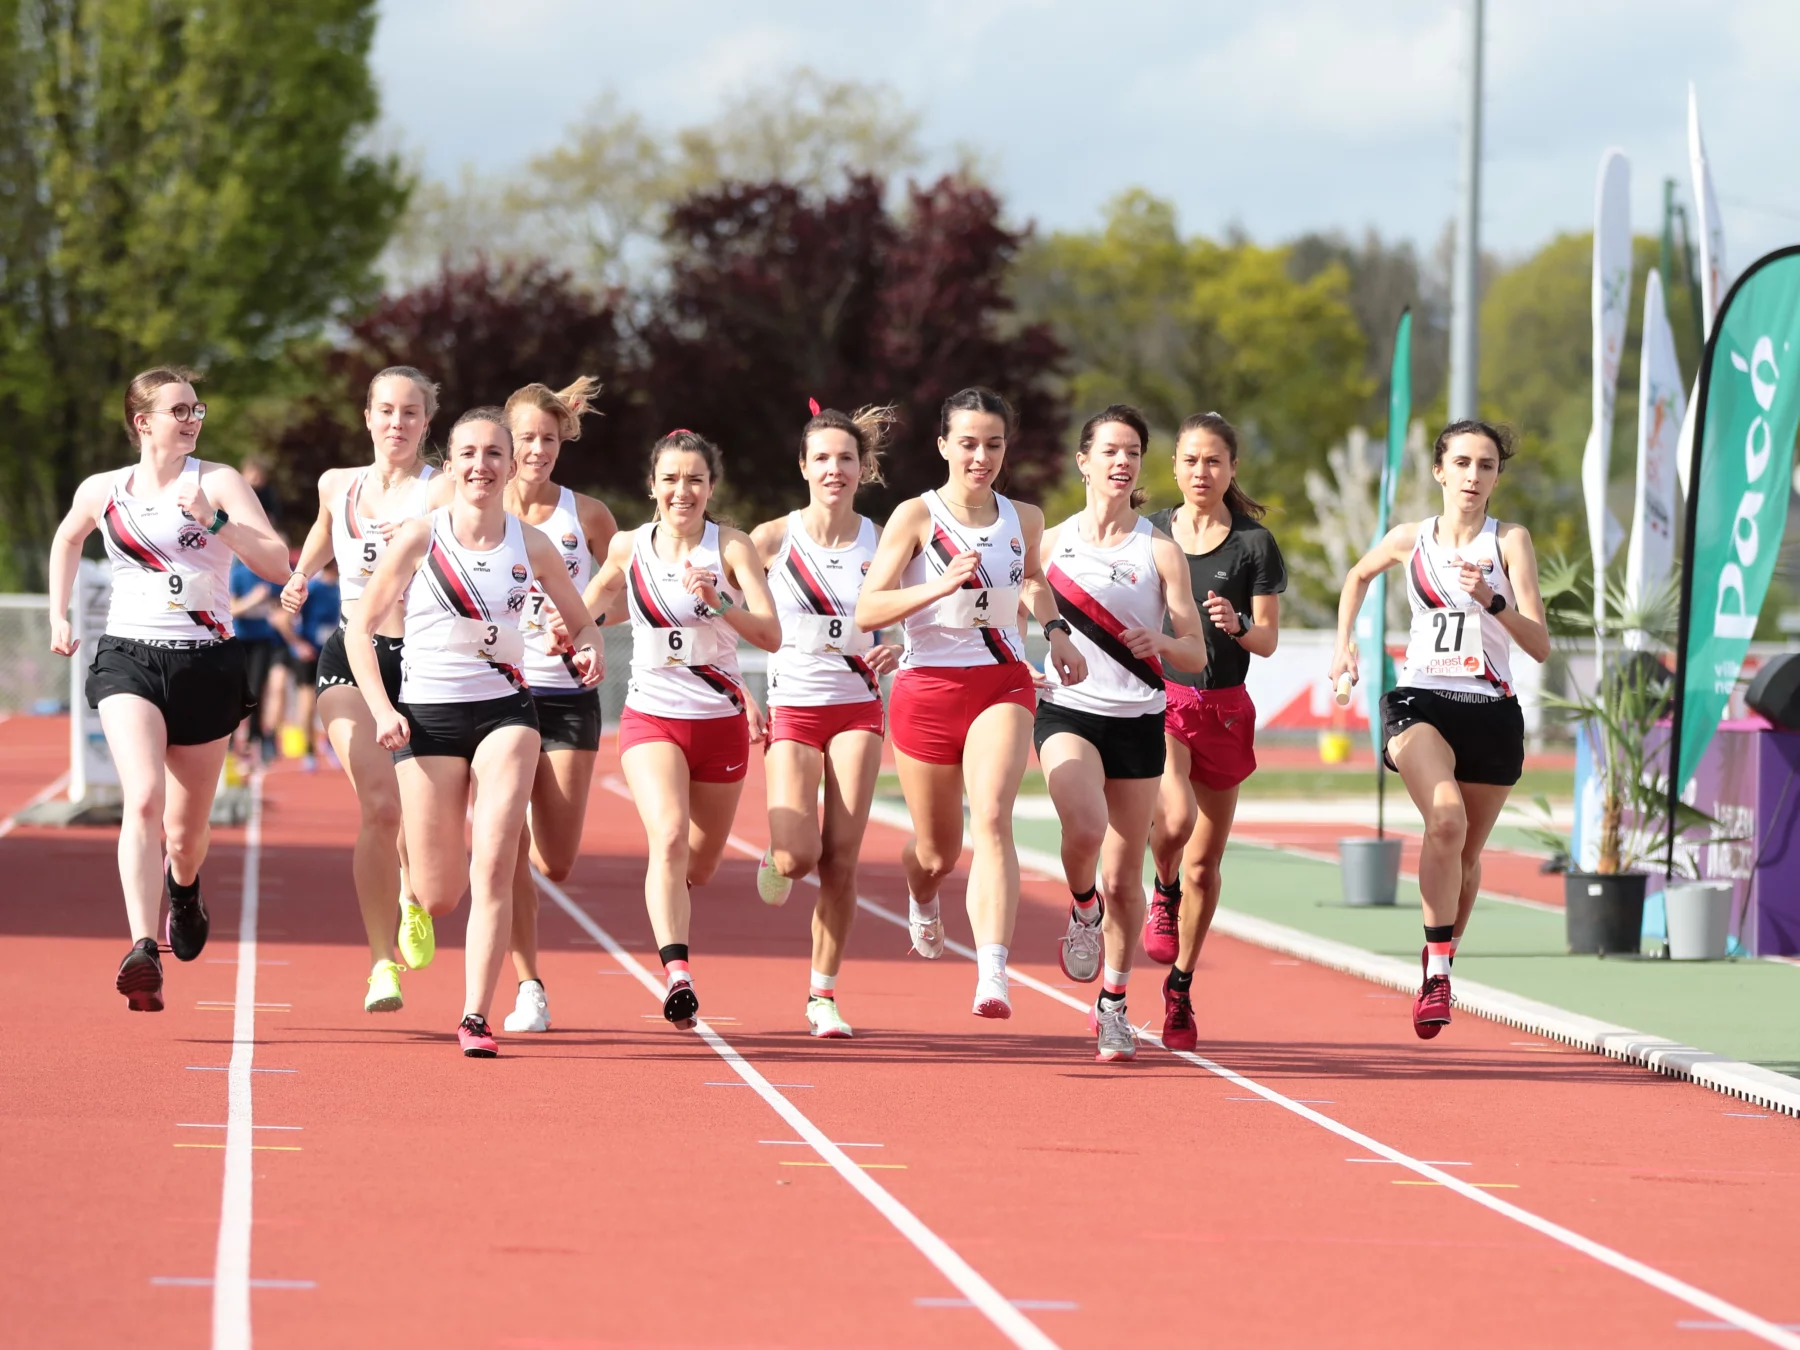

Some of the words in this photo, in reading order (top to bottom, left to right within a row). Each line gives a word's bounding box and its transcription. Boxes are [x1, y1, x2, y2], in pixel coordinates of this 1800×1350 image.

[1713, 336, 1779, 638] Pacé
[363, 543, 377, 562] 5
[168, 574, 184, 595] 9
[531, 596, 545, 615] 7
[975, 590, 989, 611] 4
[484, 625, 499, 646] 3
[828, 619, 843, 638] 8
[1432, 612, 1466, 653] 27
[668, 630, 683, 651] 6
[1426, 665, 1462, 674] france
[1430, 655, 1462, 667] ouest
